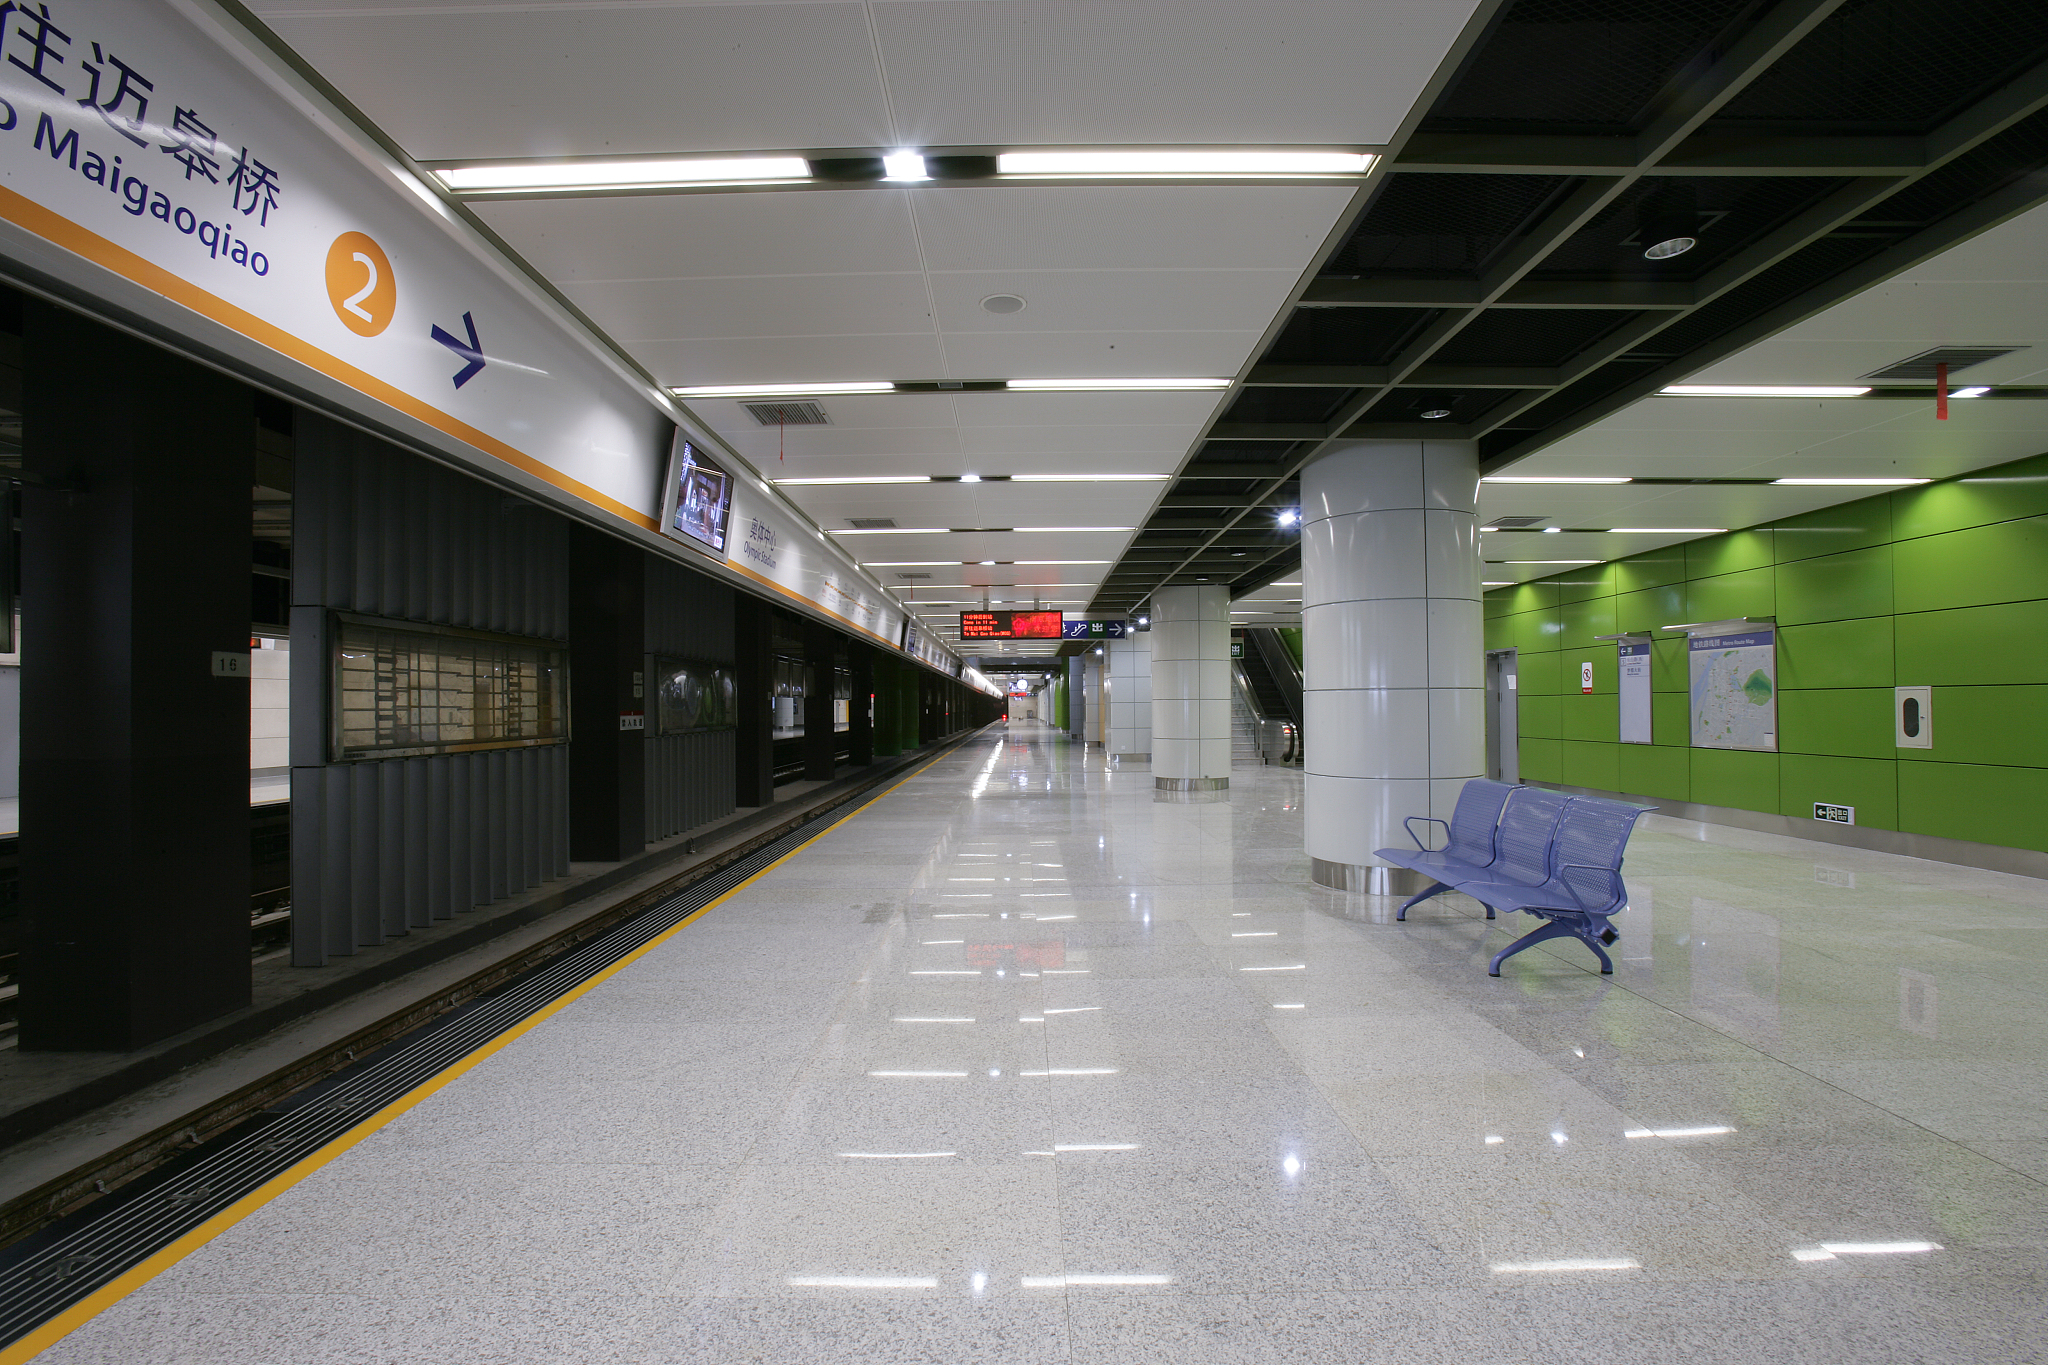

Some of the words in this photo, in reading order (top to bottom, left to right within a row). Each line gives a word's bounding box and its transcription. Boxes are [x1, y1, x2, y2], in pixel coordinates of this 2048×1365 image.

[33, 110, 270, 277] Maigaoqiao
[342, 251, 378, 324] 2
[749, 516, 777, 553] 奥体中心
[743, 540, 762, 562] Olympic
[761, 551, 777, 571] Stadium
[220, 658, 237, 672] 16
